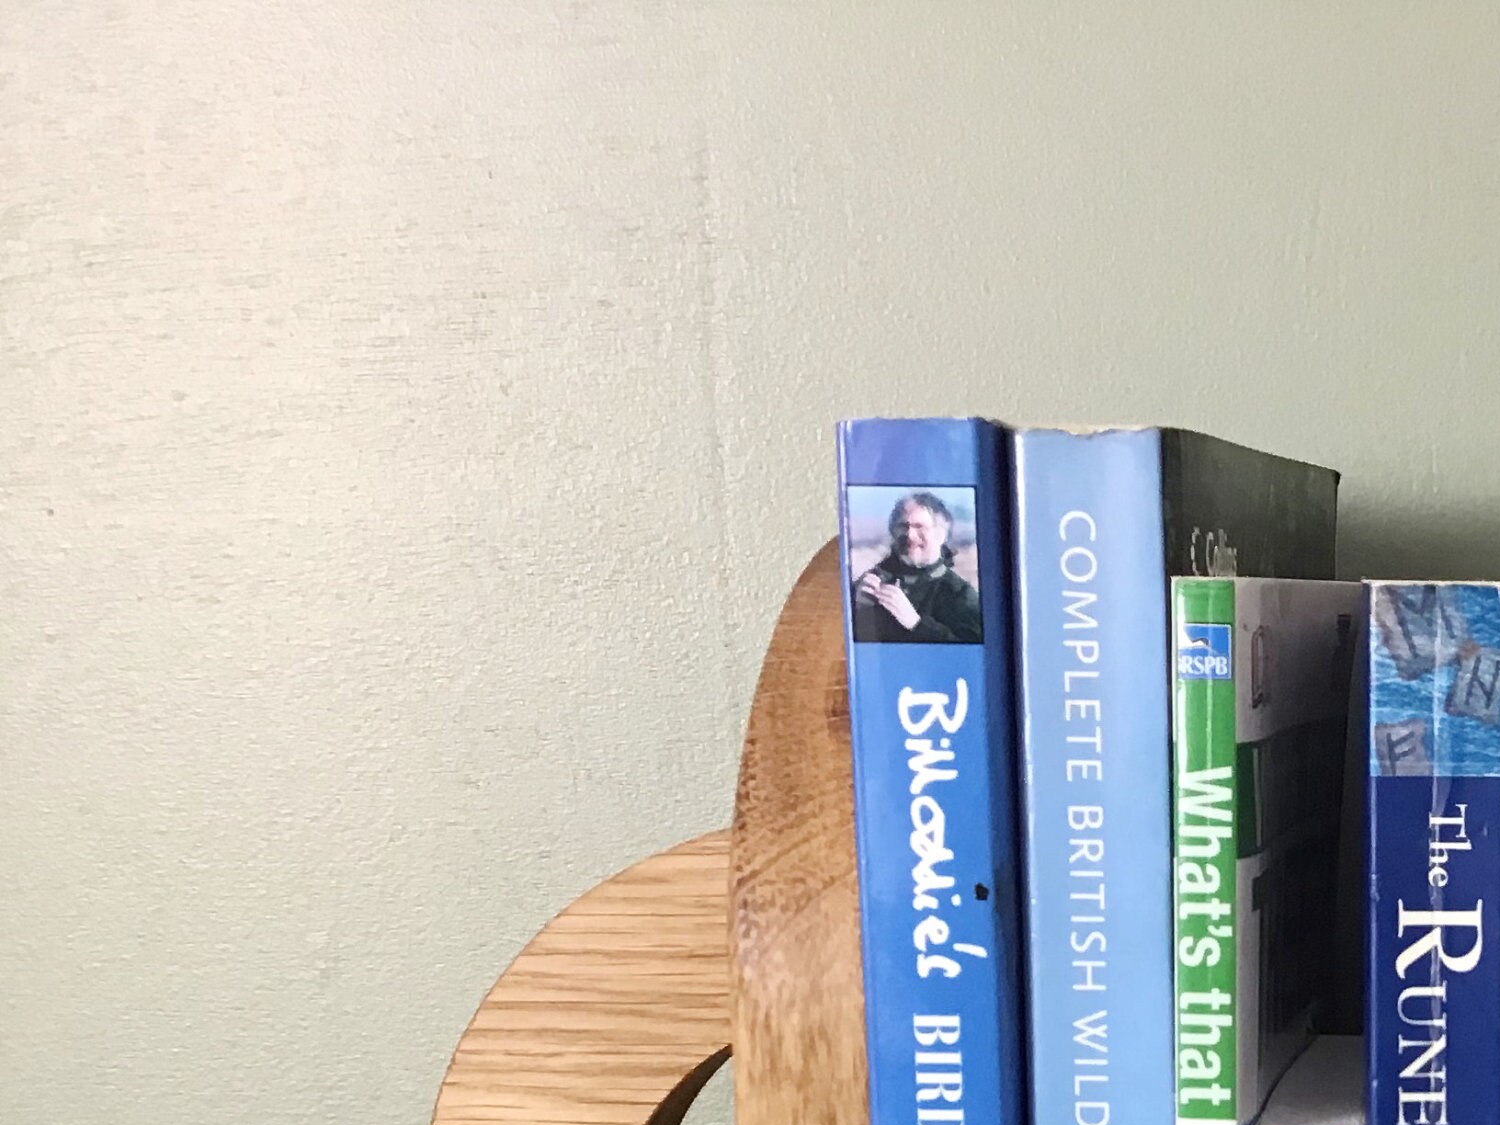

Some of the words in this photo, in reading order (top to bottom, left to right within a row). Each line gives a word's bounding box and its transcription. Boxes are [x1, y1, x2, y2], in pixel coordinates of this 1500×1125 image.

[1058, 510, 1103, 782] COMPLETE
[1179, 655, 1229, 676] RSPB
[898, 677, 968, 795] Bill
[1067, 804, 1108, 992] BRITISH
[1178, 765, 1234, 968] What's
[1427, 803, 1473, 888] The
[1179, 987, 1234, 1107] that
